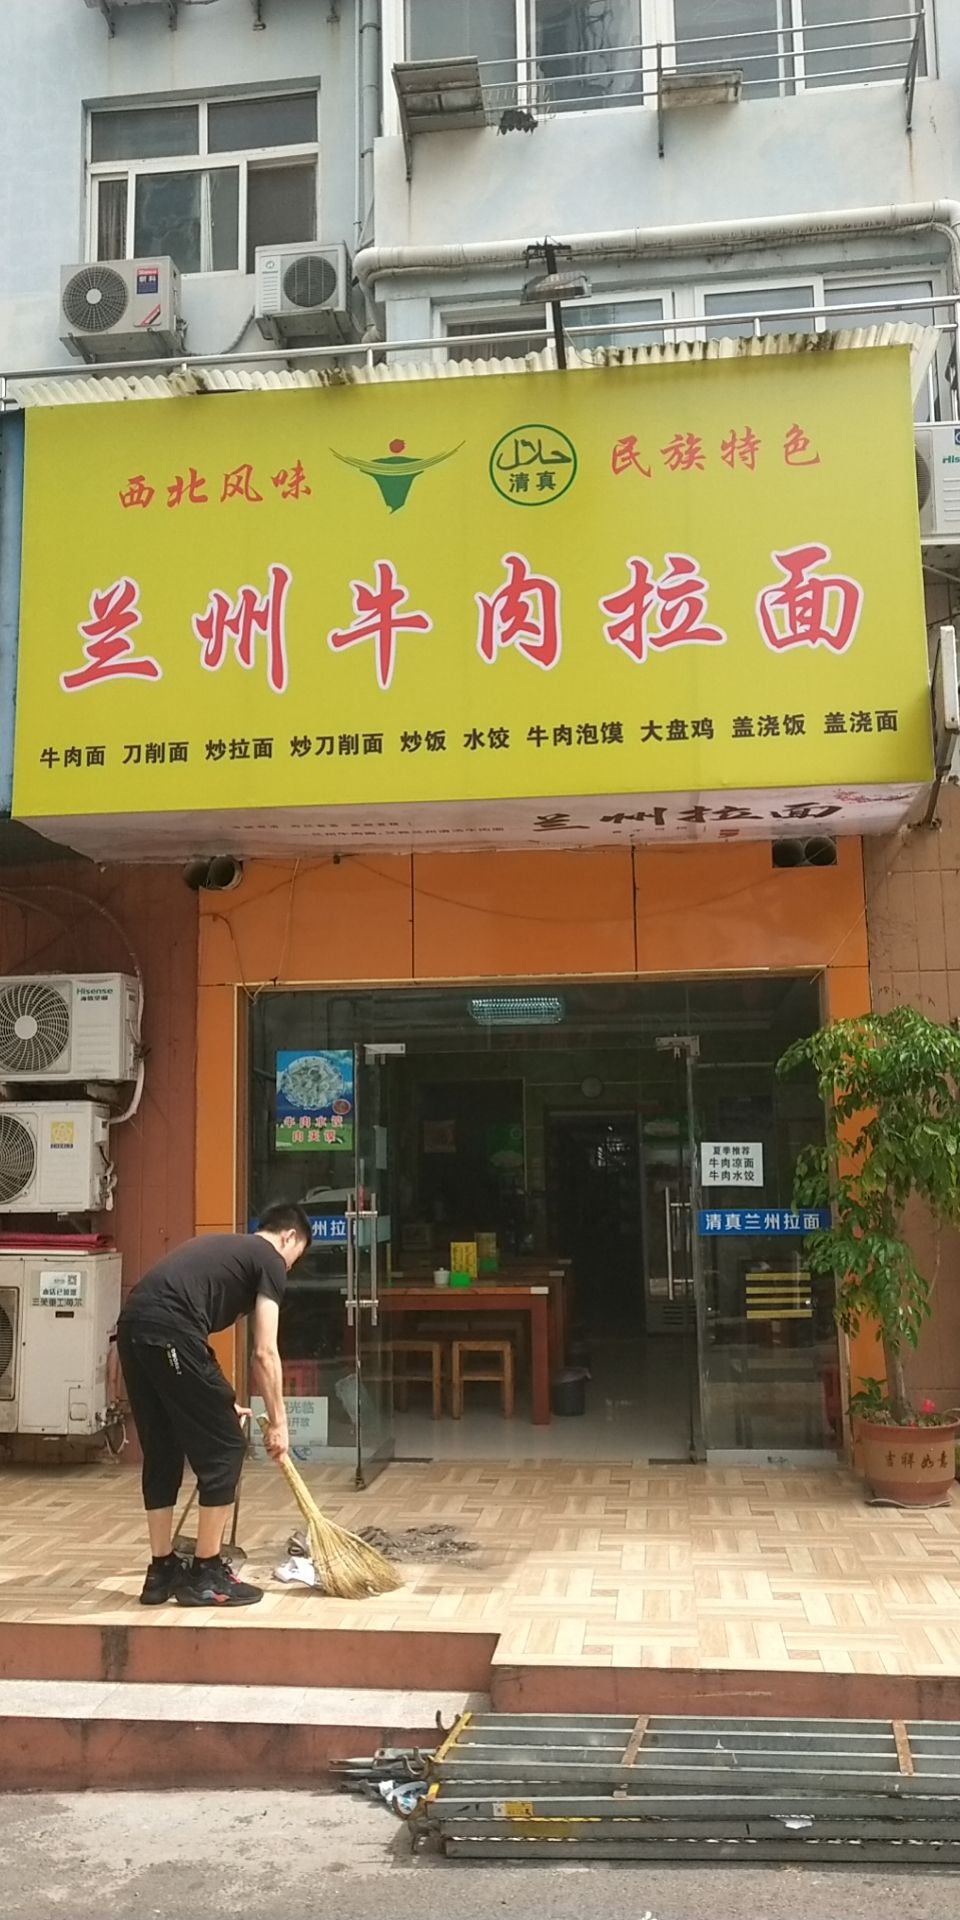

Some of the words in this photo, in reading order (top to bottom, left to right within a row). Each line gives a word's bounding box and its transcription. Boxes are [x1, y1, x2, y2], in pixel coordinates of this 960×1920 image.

[610, 423, 822, 478] 民族特色
[118, 459, 313, 508] 西北风味
[508, 470, 557, 493] 清真
[60, 542, 865, 693] 兰州牛肉拉面
[40, 745, 106, 768] 牛肉面
[122, 741, 189, 765] 刀削面
[205, 737, 273, 761] 炒拉面
[290, 733, 384, 758] 炒刀削面
[400, 729, 446, 753] 炒饭
[463, 727, 510, 751] 水饺
[526, 720, 624, 747] 牛肉泡馍
[640, 718, 715, 744] 大盘鸡
[731, 713, 806, 739] 盖浇饭
[823, 709, 899, 735] 盖浇面
[532, 801, 842, 831] 兰州拉面
[709, 1158, 754, 1168] 牛肉凉面
[713, 1146, 750, 1155] 夏季推荐
[709, 1170, 755, 1181] 牛肉水饺
[705, 1213, 820, 1230] 清真兰州拉面
